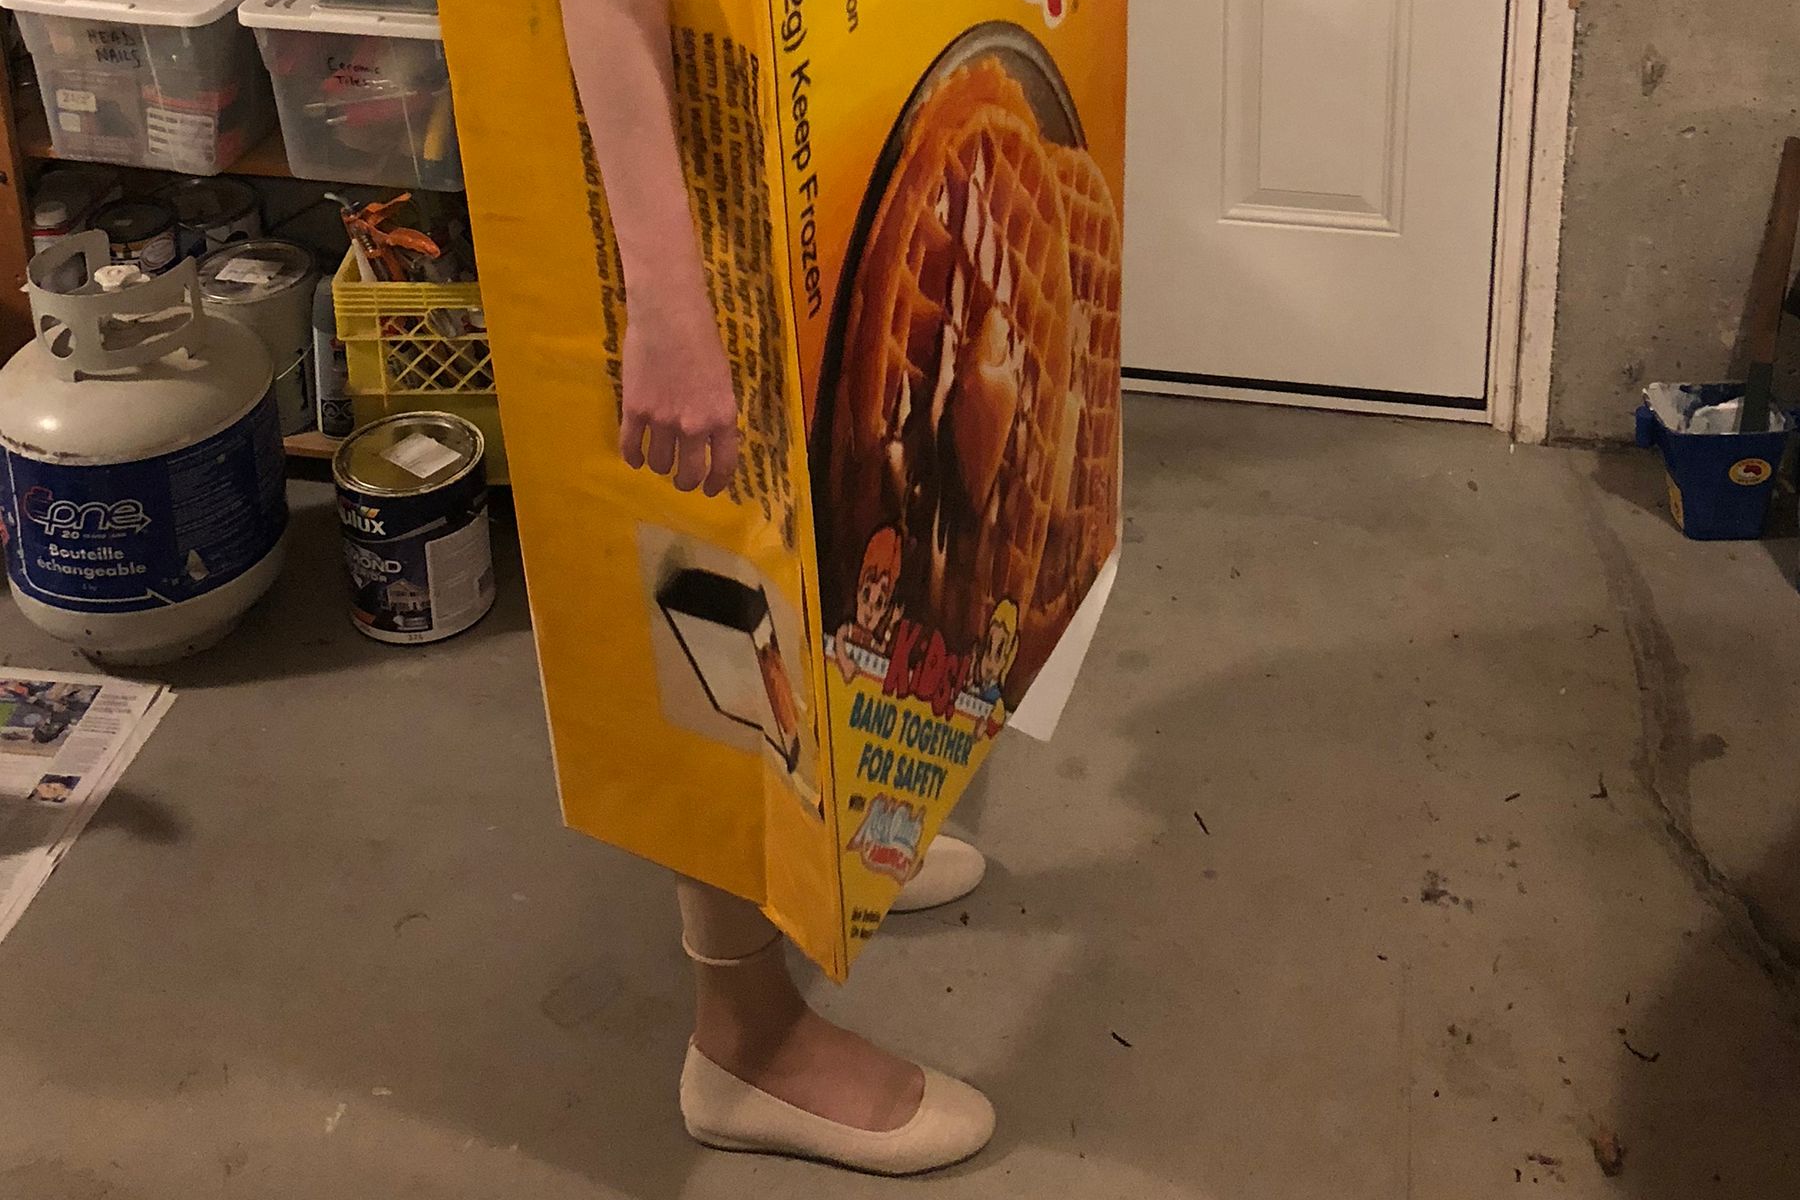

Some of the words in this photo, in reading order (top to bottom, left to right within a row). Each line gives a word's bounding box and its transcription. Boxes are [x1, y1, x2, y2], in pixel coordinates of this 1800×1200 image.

[95, 47, 142, 69] NAILS
[701, 32, 719, 88] warm
[706, 94, 725, 146] plate
[790, 58, 812, 173] Keep
[712, 151, 728, 193] with
[728, 141, 748, 209] toaster
[715, 198, 732, 253] warm
[798, 170, 823, 320] Frozen
[716, 258, 734, 312] syrup
[725, 318, 740, 356] and
[60, 529, 81, 540] 20
[340, 508, 387, 536] ulux
[36, 555, 148, 580] échangeable
[48, 543, 125, 561] Bouteille
[848, 690, 898, 741] BAND
[897, 707, 976, 767] TOGETHER
[856, 740, 895, 786] FOR
[893, 752, 949, 801] SAFETY
